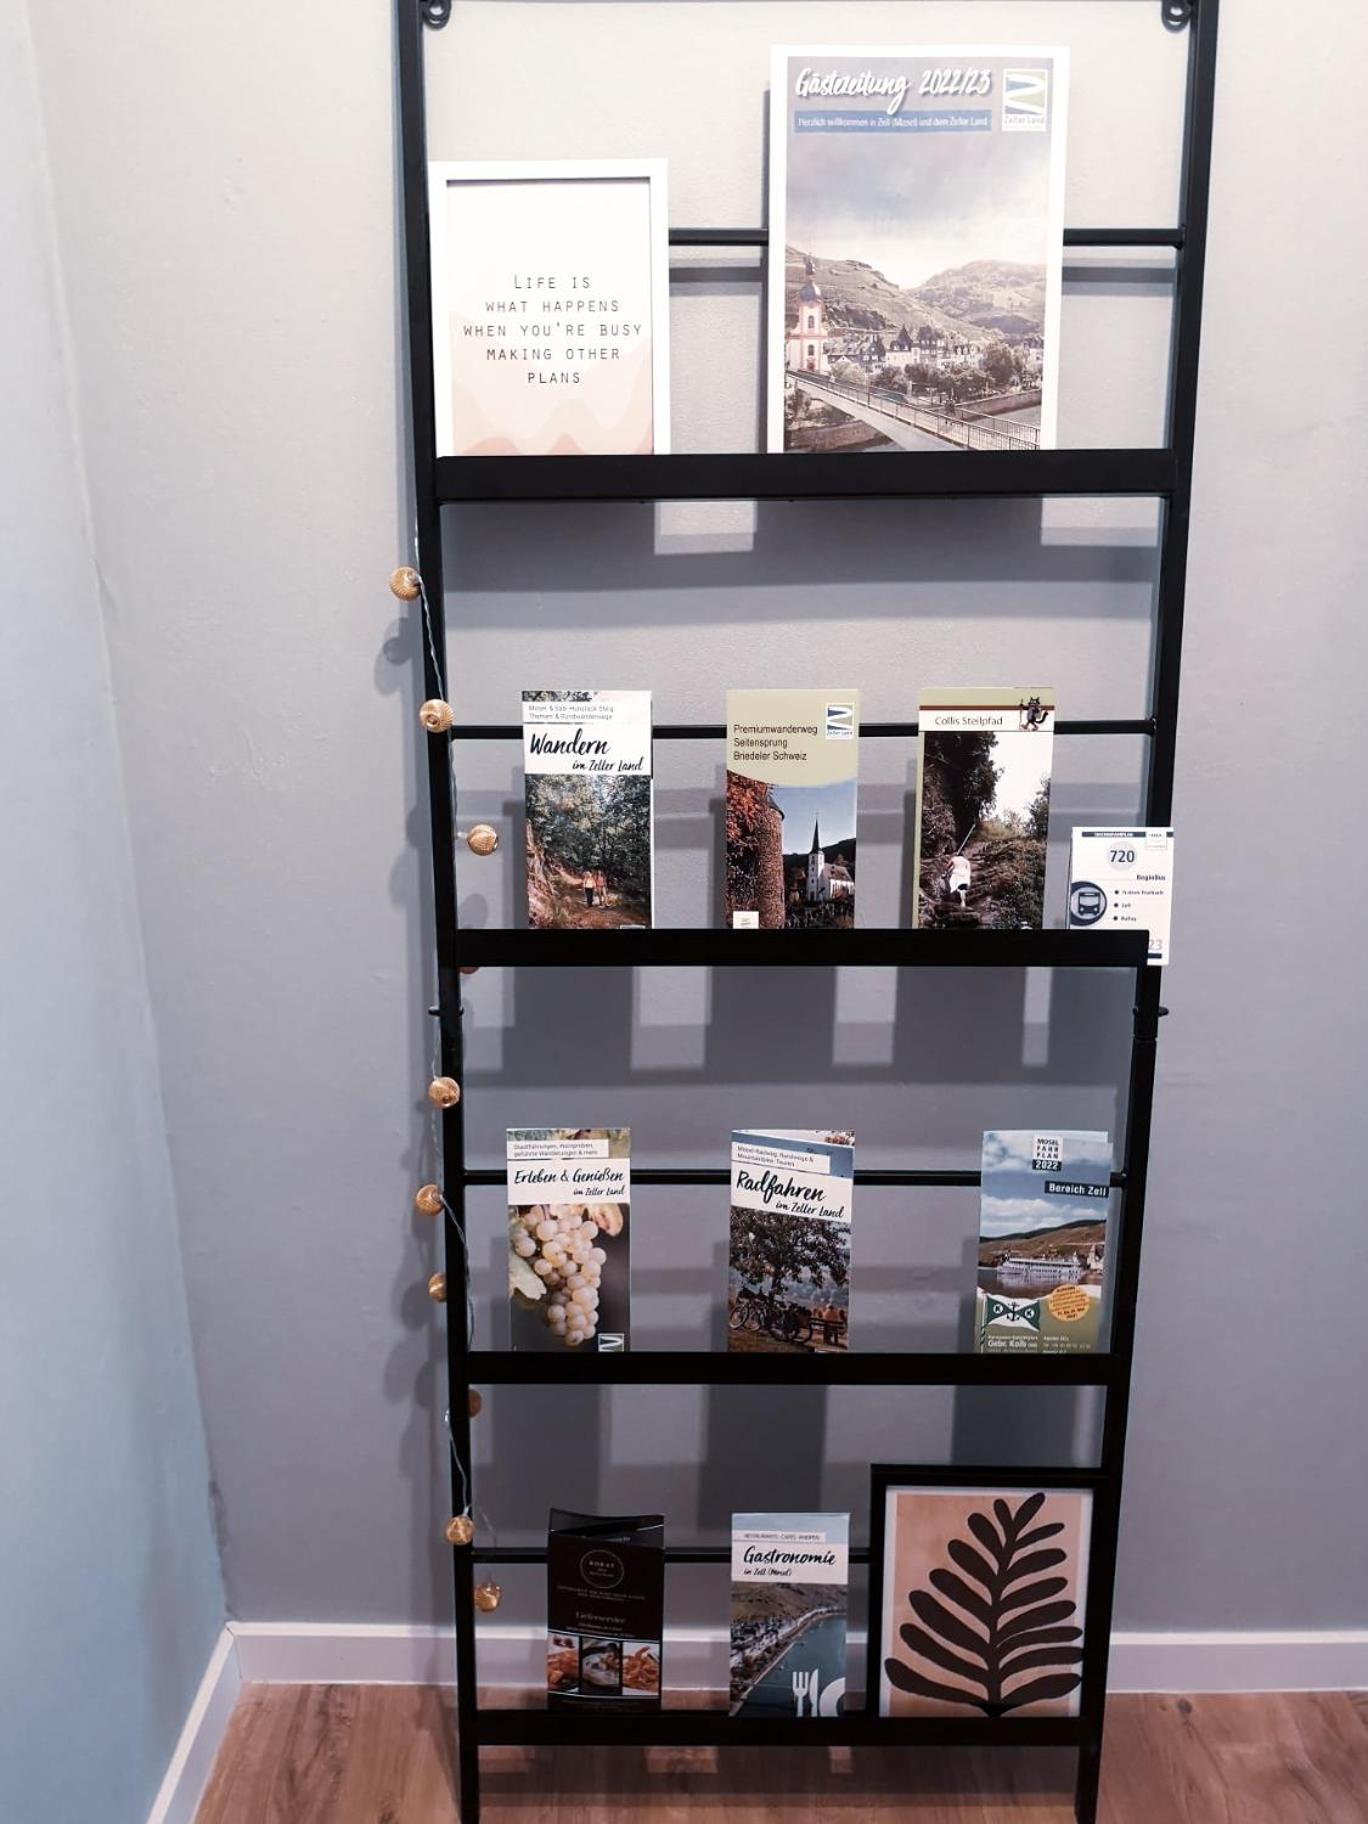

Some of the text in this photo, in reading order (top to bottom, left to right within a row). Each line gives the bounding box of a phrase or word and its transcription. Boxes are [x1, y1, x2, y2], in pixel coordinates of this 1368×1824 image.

[795, 67, 991, 115] Gästezeitung 2022/23
[572, 277, 591, 289] IS
[485, 300, 620, 312] WHAT HAPPENS
[463, 321, 642, 337] WHEN YOU'RE BUSY
[486, 348, 620, 361] MAKING OTHER
[527, 371, 581, 384] PLANS
[961, 716, 1003, 727] Steilpfad
[733, 724, 818, 736] Premiumwanderweg
[530, 728, 611, 755] Wandern
[733, 737, 788, 749] Seitensprung
[772, 750, 807, 760] Schweiz
[572, 756, 644, 772] im Zeller Land
[1109, 850, 1135, 863] 720
[1037, 1138, 1059, 1146] MOSEL
[1035, 1160, 1058, 1170] 2022
[514, 1167, 624, 1184] Erleben & Genießen
[573, 1185, 625, 1196] im Zeller Land
[736, 1170, 826, 1204] Radfahren
[1049, 1182, 1106, 1196] Bereich Zell
[775, 1200, 845, 1218] im Zeller Land
[743, 1545, 837, 1566] Gastronomie
[753, 1568, 766, 1576] Zell
